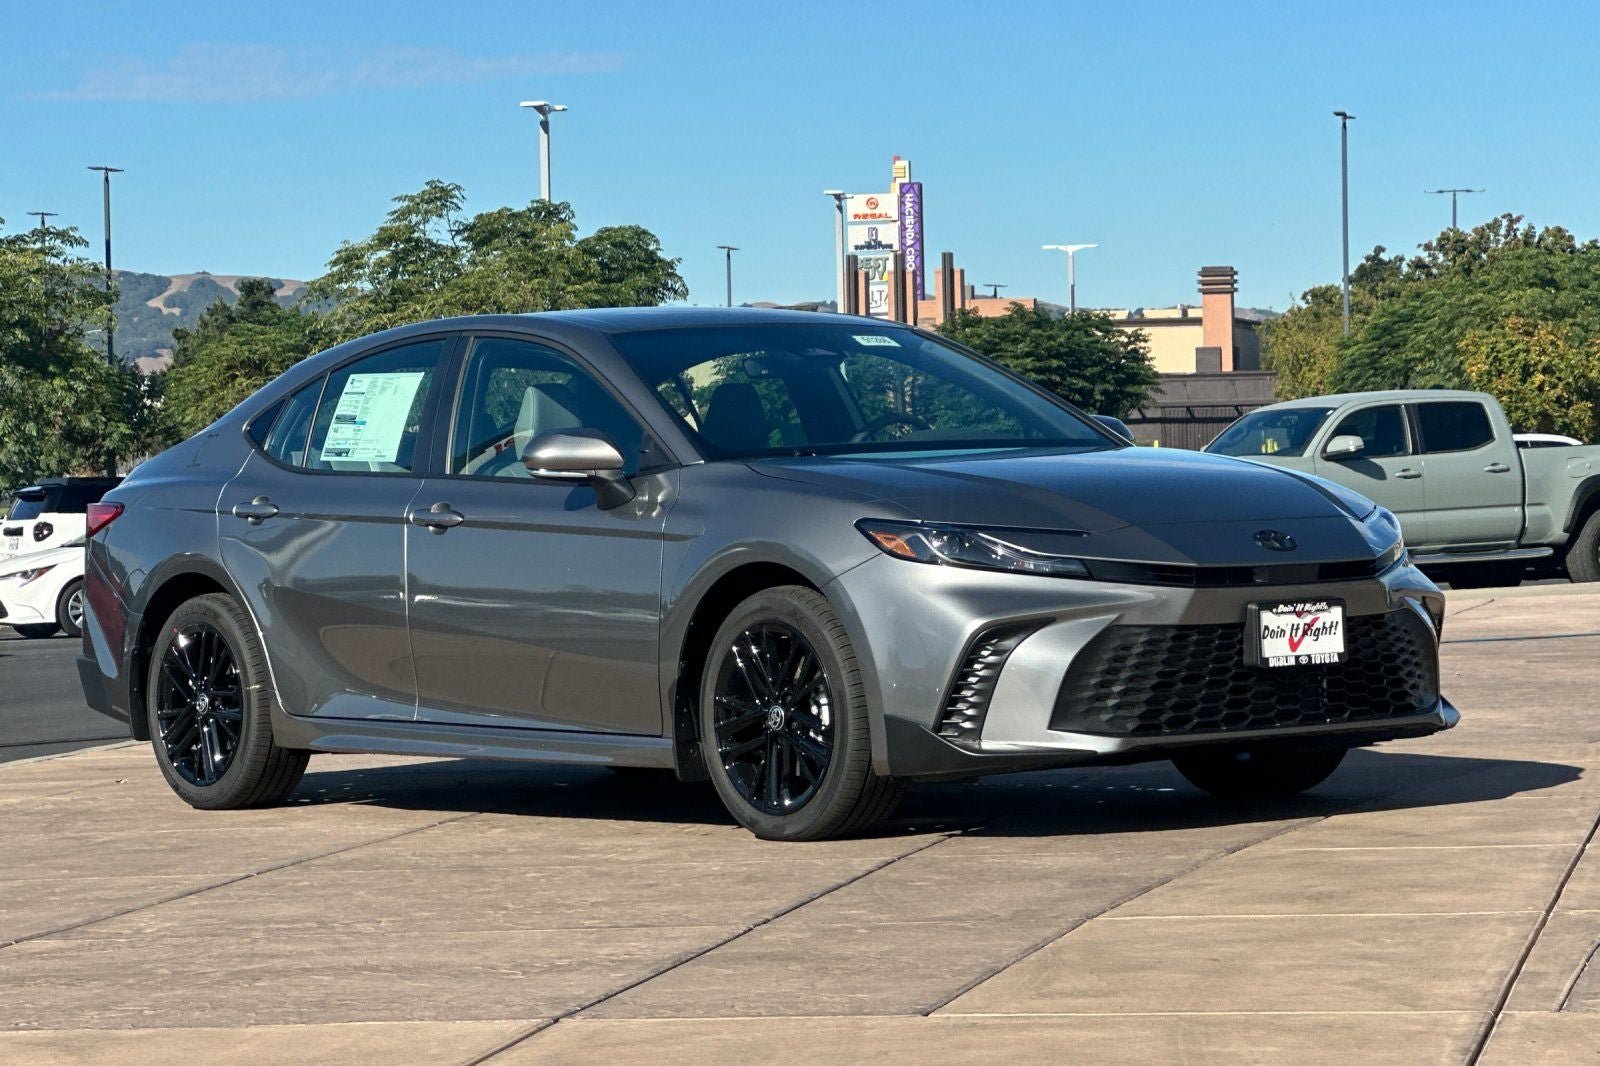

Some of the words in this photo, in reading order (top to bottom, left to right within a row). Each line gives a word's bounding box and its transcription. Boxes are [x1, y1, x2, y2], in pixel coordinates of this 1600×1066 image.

[853, 212, 892, 220] REGAL
[905, 193, 914, 247] HACIENDA
[906, 247, 915, 271] CRO
[1290, 622, 1301, 638] It
[1303, 620, 1339, 641] Right!
[1268, 655, 1296, 668] DUBLIN
[1310, 652, 1340, 665] TOYOTA
